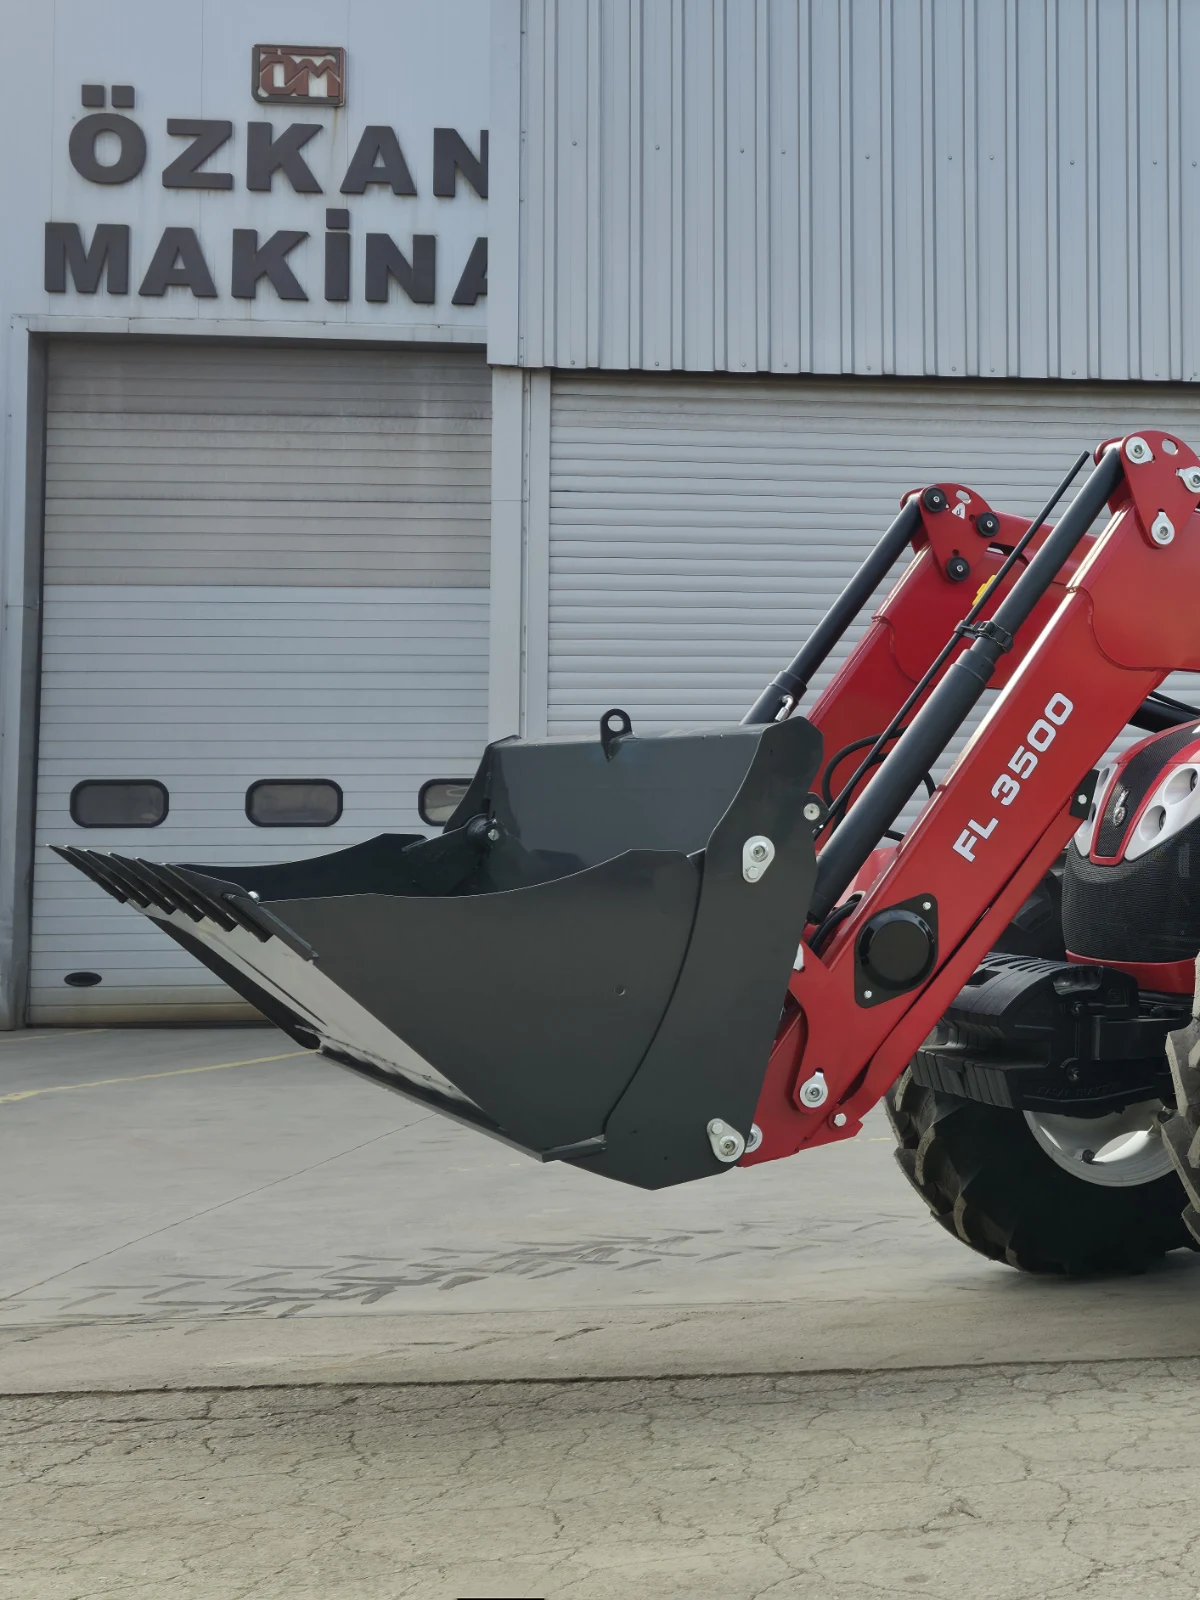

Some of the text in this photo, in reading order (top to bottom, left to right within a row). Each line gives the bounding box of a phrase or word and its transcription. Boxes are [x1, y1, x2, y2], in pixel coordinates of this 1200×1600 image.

[69, 84, 488, 198] ÖZKAN
[952, 692, 1074, 863] FL 3500
